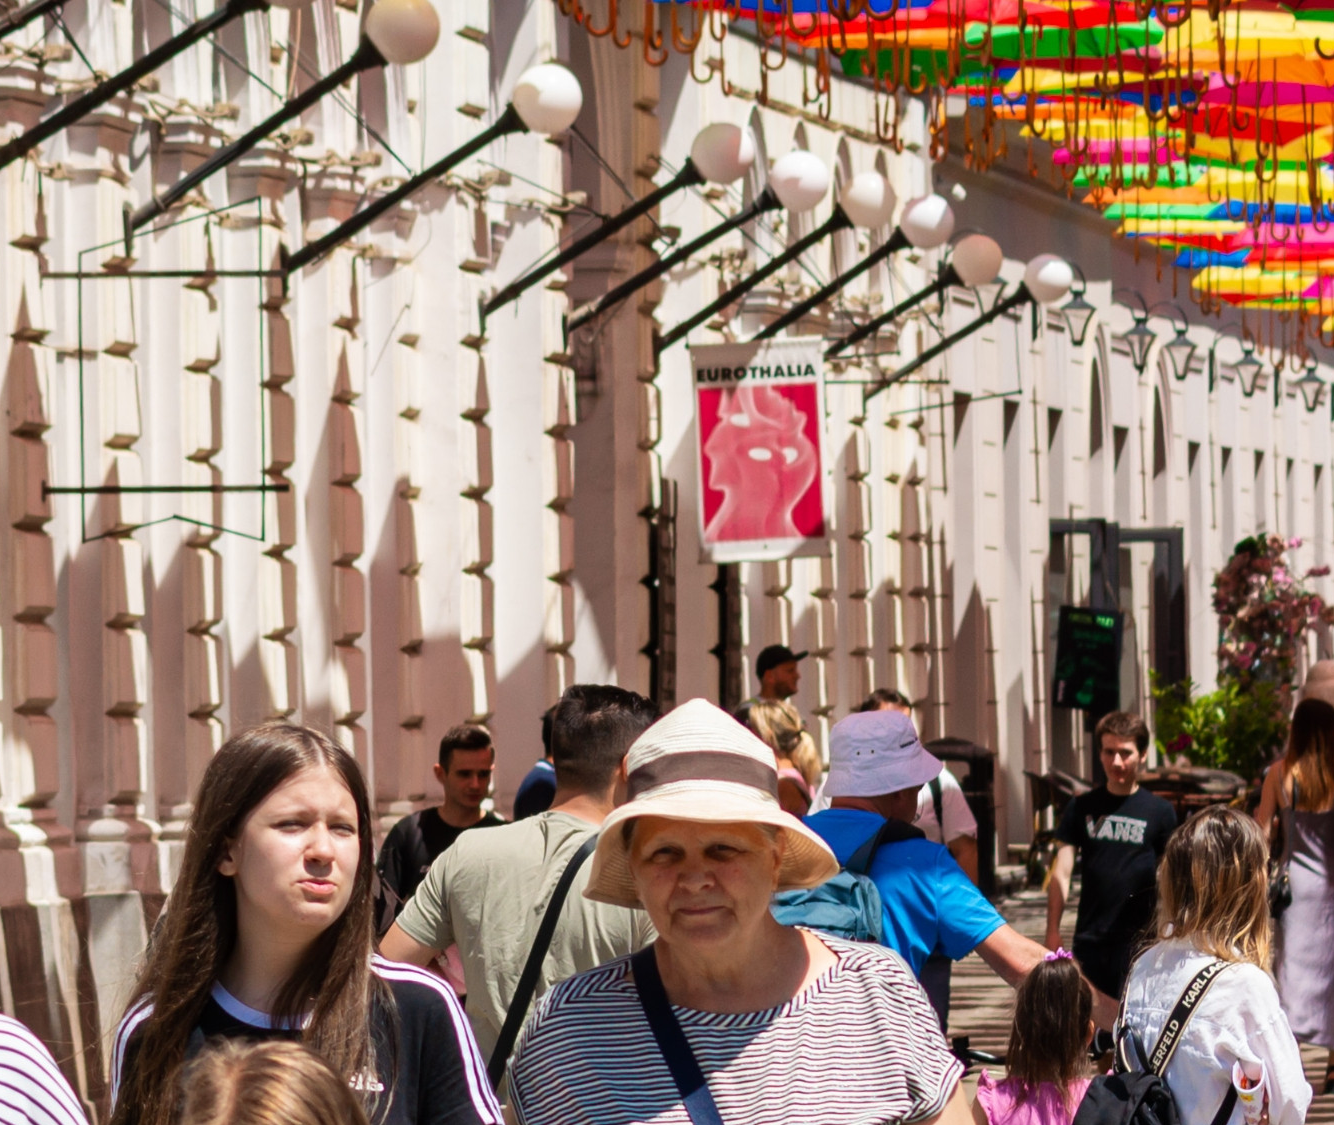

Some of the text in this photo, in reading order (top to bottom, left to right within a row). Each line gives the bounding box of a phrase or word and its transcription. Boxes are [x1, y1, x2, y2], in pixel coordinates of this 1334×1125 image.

[696, 363, 816, 382] EUROTHALIA
[1085, 814, 1148, 844] VANS
[1182, 977, 1208, 1008] KARL
